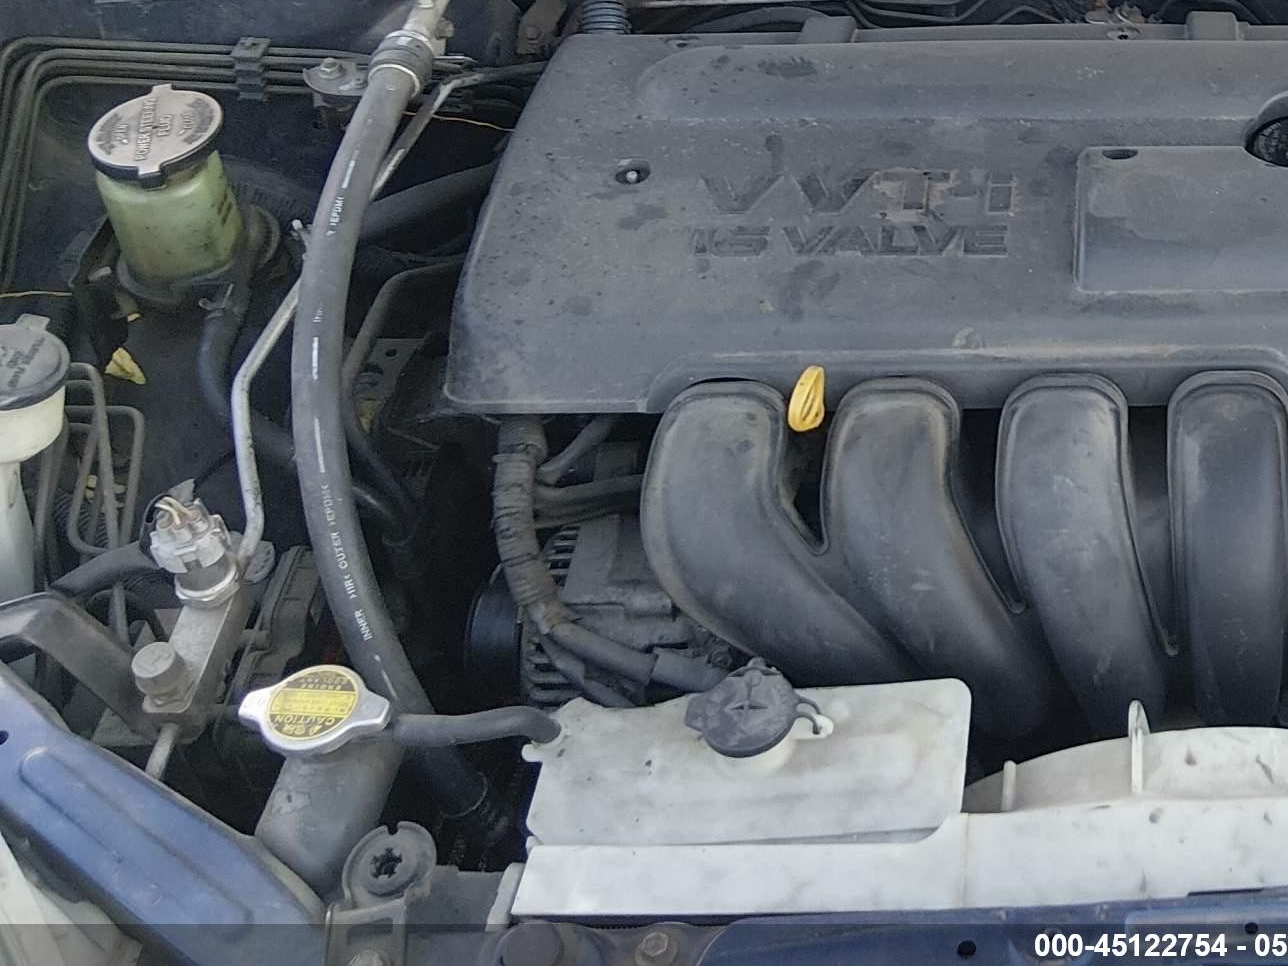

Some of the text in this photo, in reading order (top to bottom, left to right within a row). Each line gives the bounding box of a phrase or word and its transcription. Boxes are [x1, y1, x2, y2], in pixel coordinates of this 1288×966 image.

[781, 223, 1010, 258] VALVE
[331, 532, 348, 569] OUTER
[274, 714, 336, 726] CAUTION
